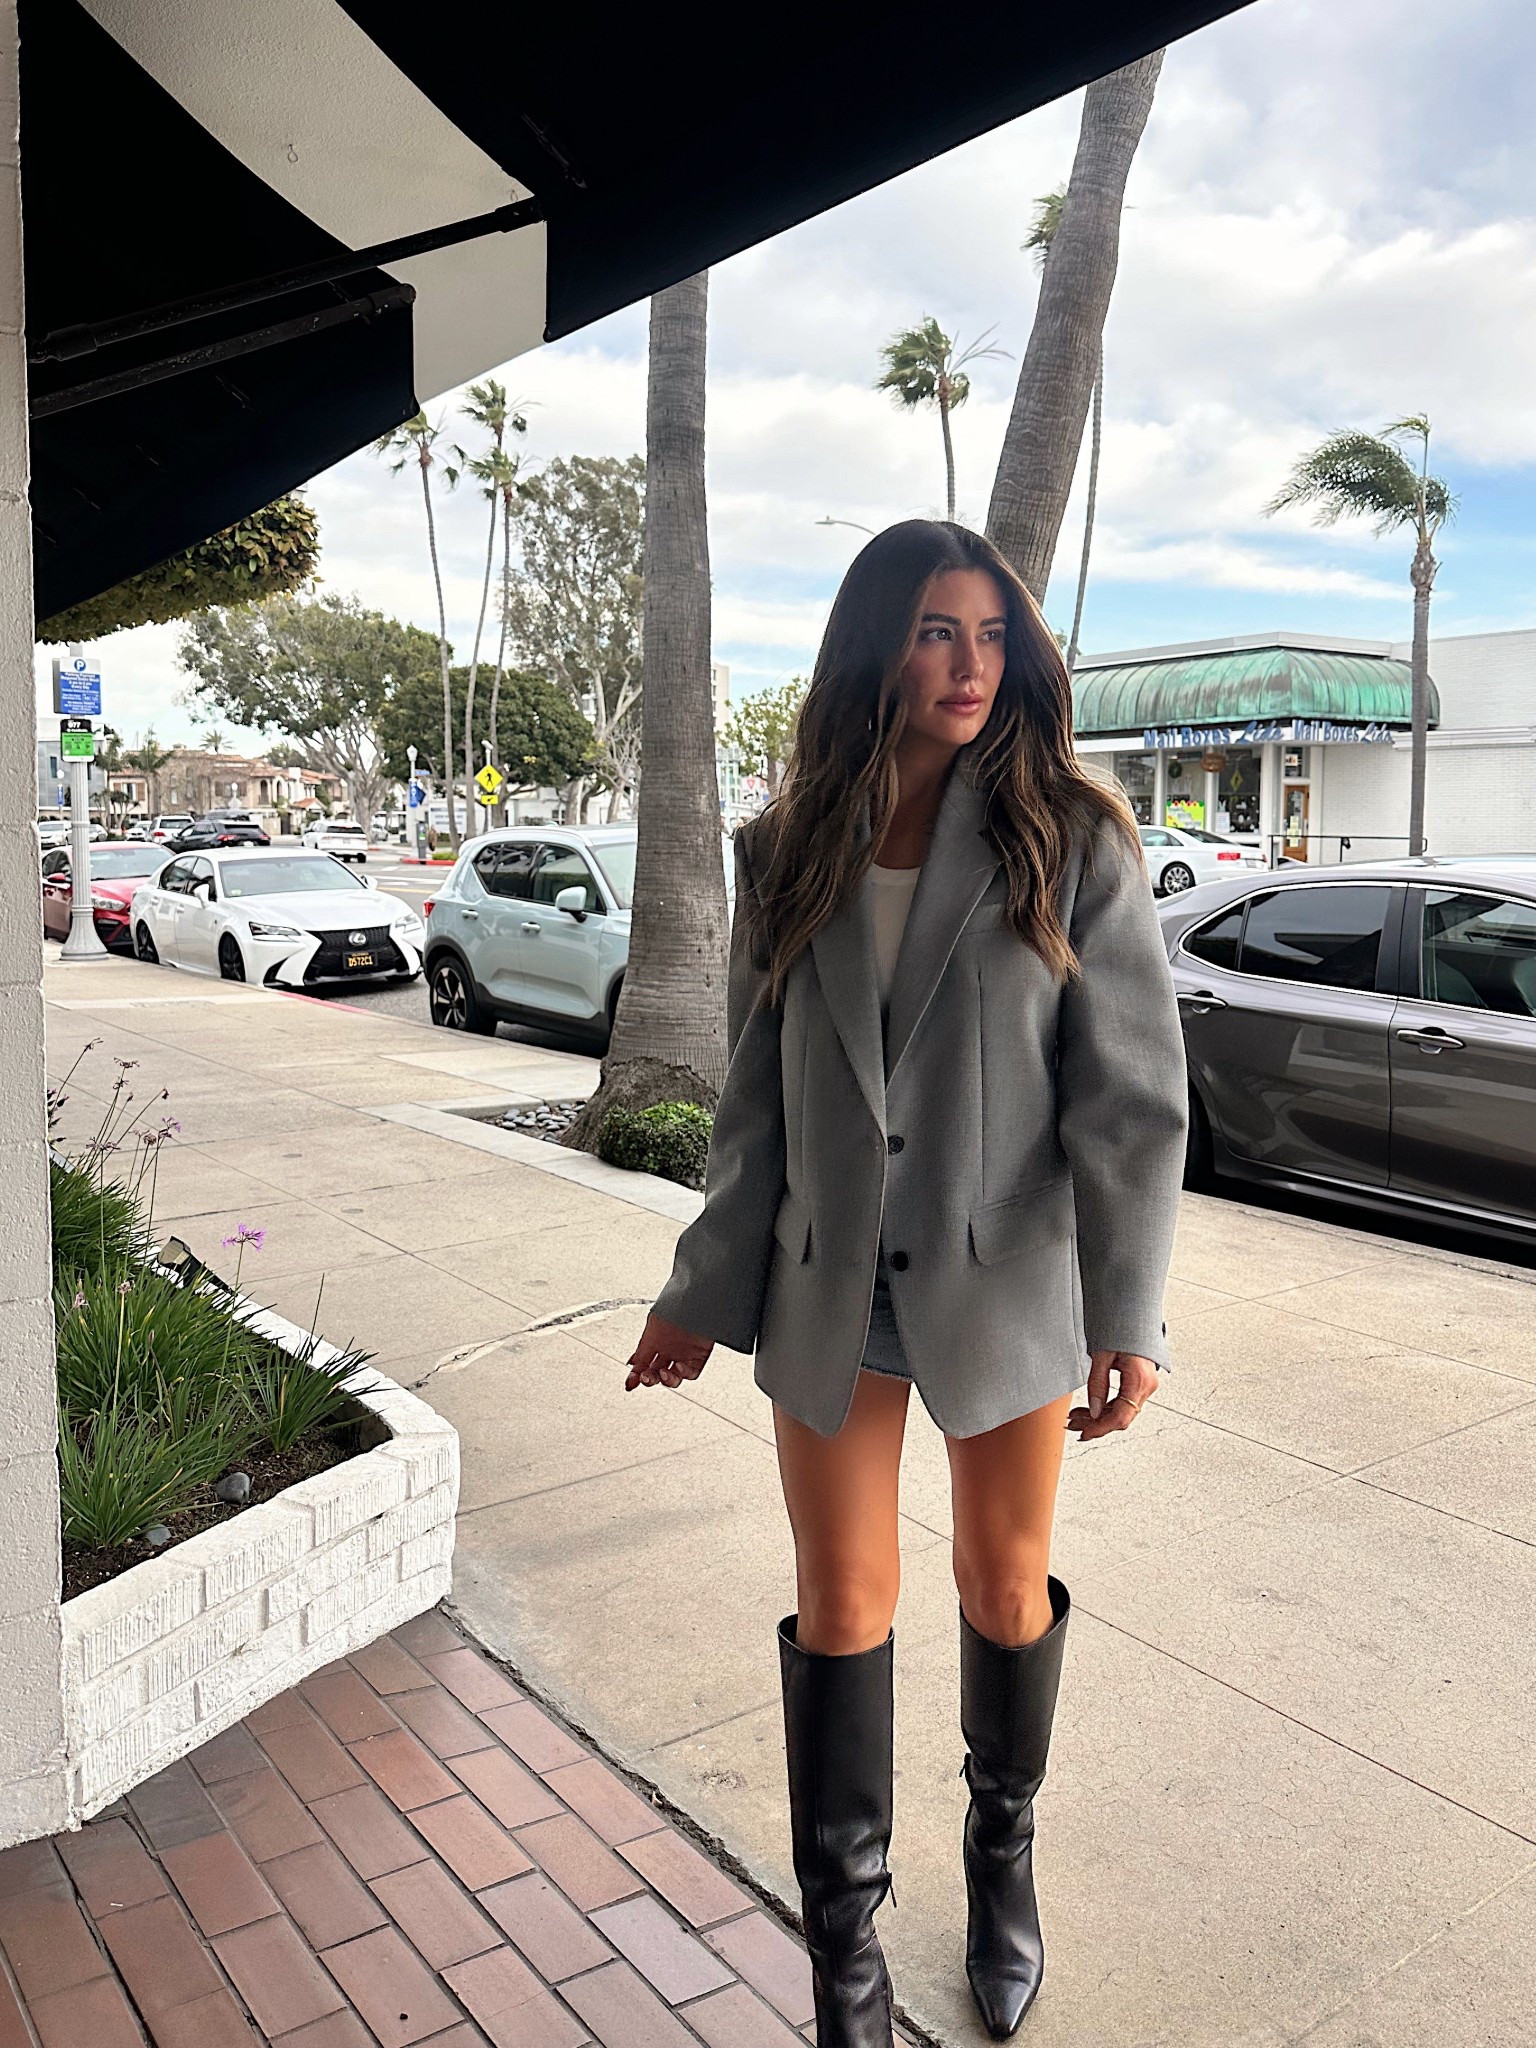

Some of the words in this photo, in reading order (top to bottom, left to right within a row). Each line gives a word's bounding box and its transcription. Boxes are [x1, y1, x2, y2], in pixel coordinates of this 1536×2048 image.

[1143, 727, 1178, 748] Mail
[1181, 727, 1232, 747] Boxes
[1292, 719, 1320, 741] Mail
[1322, 720, 1360, 742] Boxes
